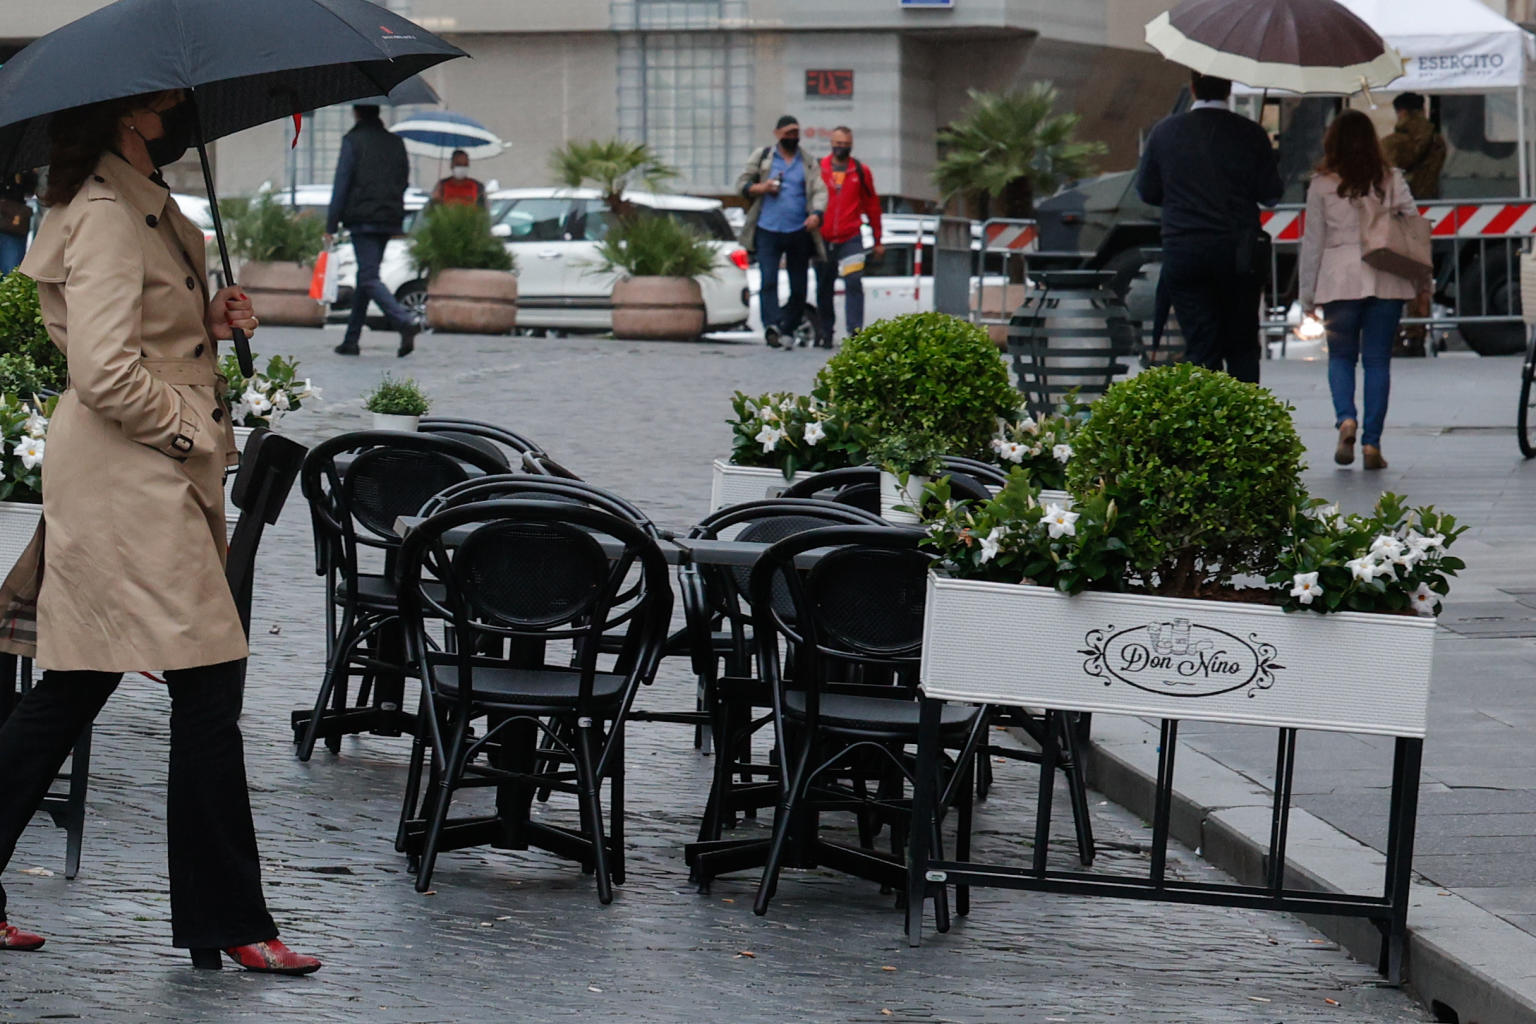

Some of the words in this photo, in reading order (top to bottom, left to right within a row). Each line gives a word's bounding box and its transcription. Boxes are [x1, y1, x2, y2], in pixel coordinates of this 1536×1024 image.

[1417, 53, 1504, 70] ESERCITO
[1120, 643, 1173, 672] Don
[1177, 651, 1241, 677] Nino
